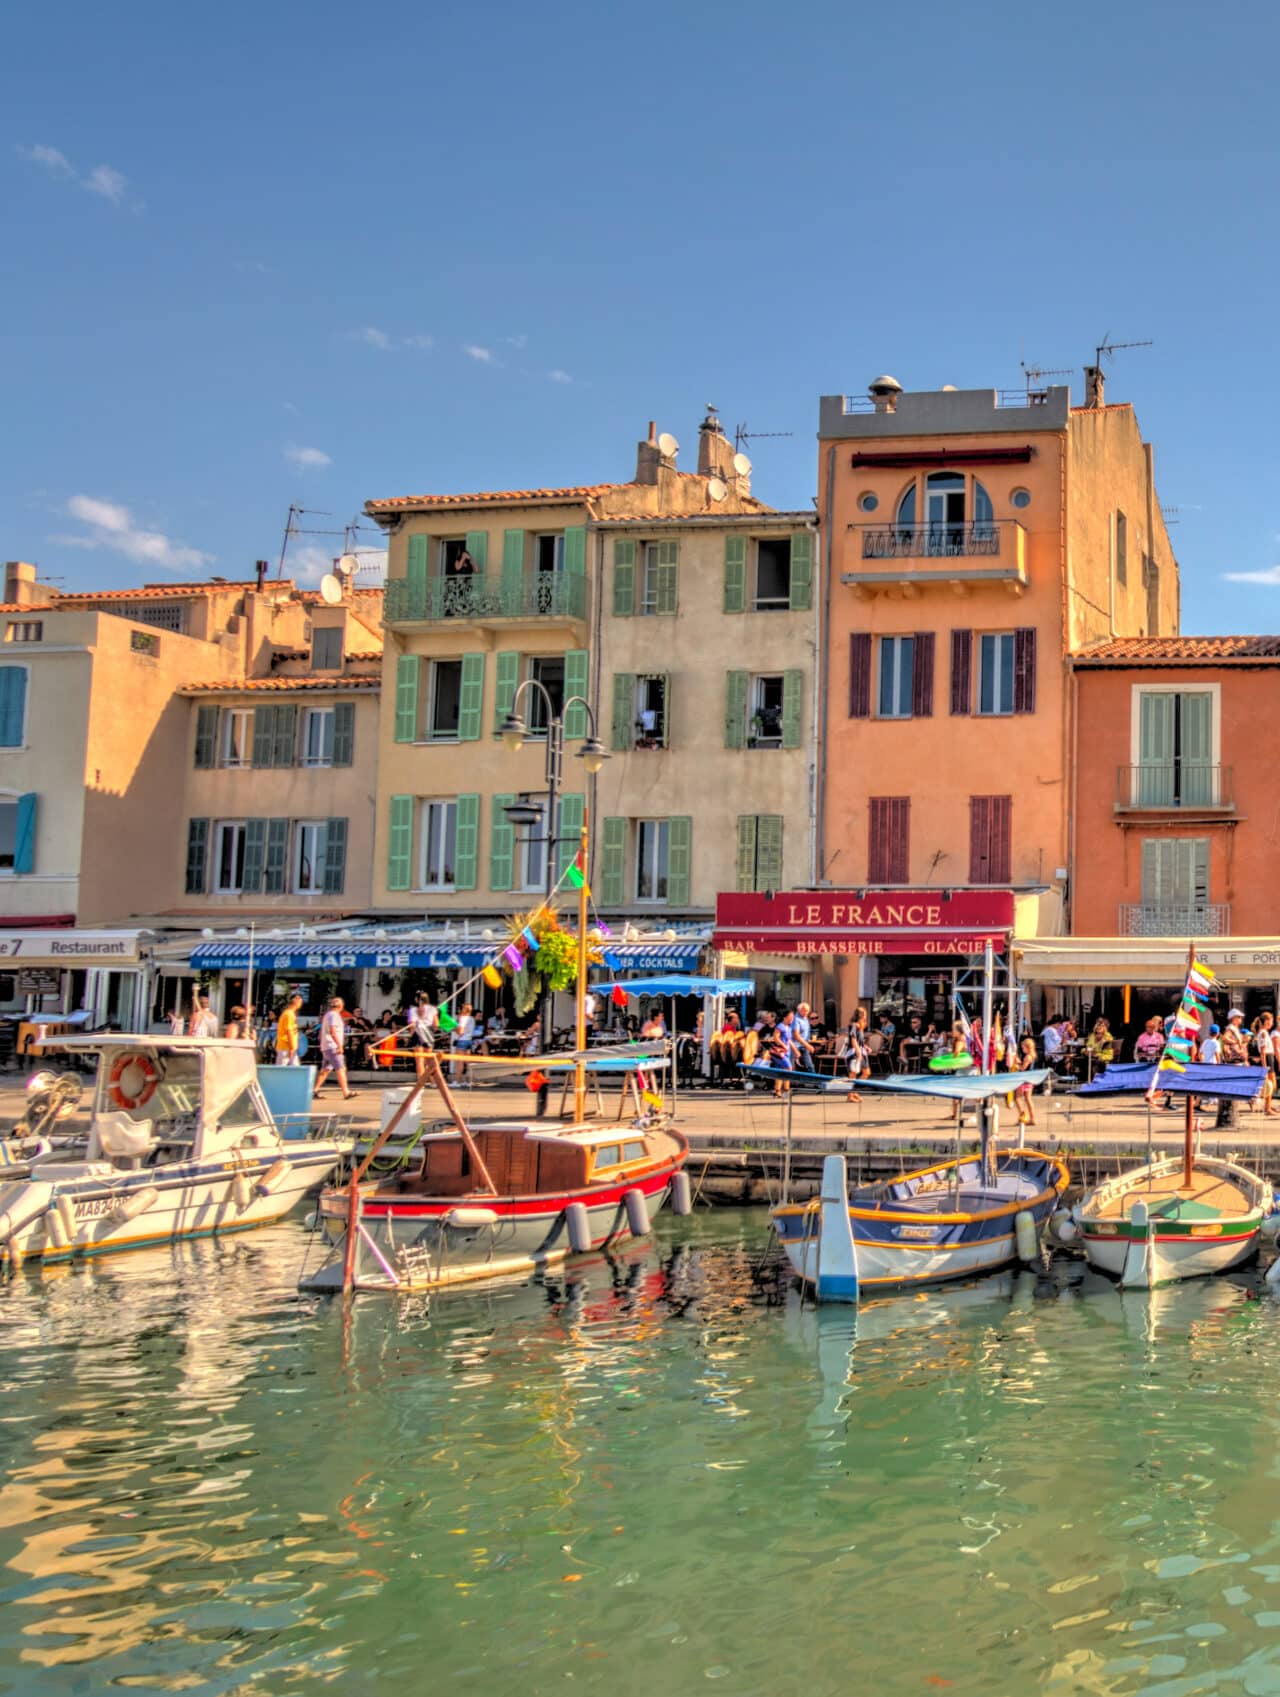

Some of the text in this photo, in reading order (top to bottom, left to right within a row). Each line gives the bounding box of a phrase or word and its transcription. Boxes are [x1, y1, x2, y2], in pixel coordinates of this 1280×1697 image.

[788, 905, 942, 925] LE FRANCE
[50, 941, 126, 954] Restaurant
[724, 940, 756, 952] BAR
[796, 940, 884, 953] BRASSERIE
[924, 940, 988, 953] GLACIE
[305, 955, 357, 968] BAR
[375, 954, 411, 967] DE
[429, 954, 464, 967] LA
[639, 958, 684, 969] COCKTAILS
[1223, 954, 1237, 964] LE
